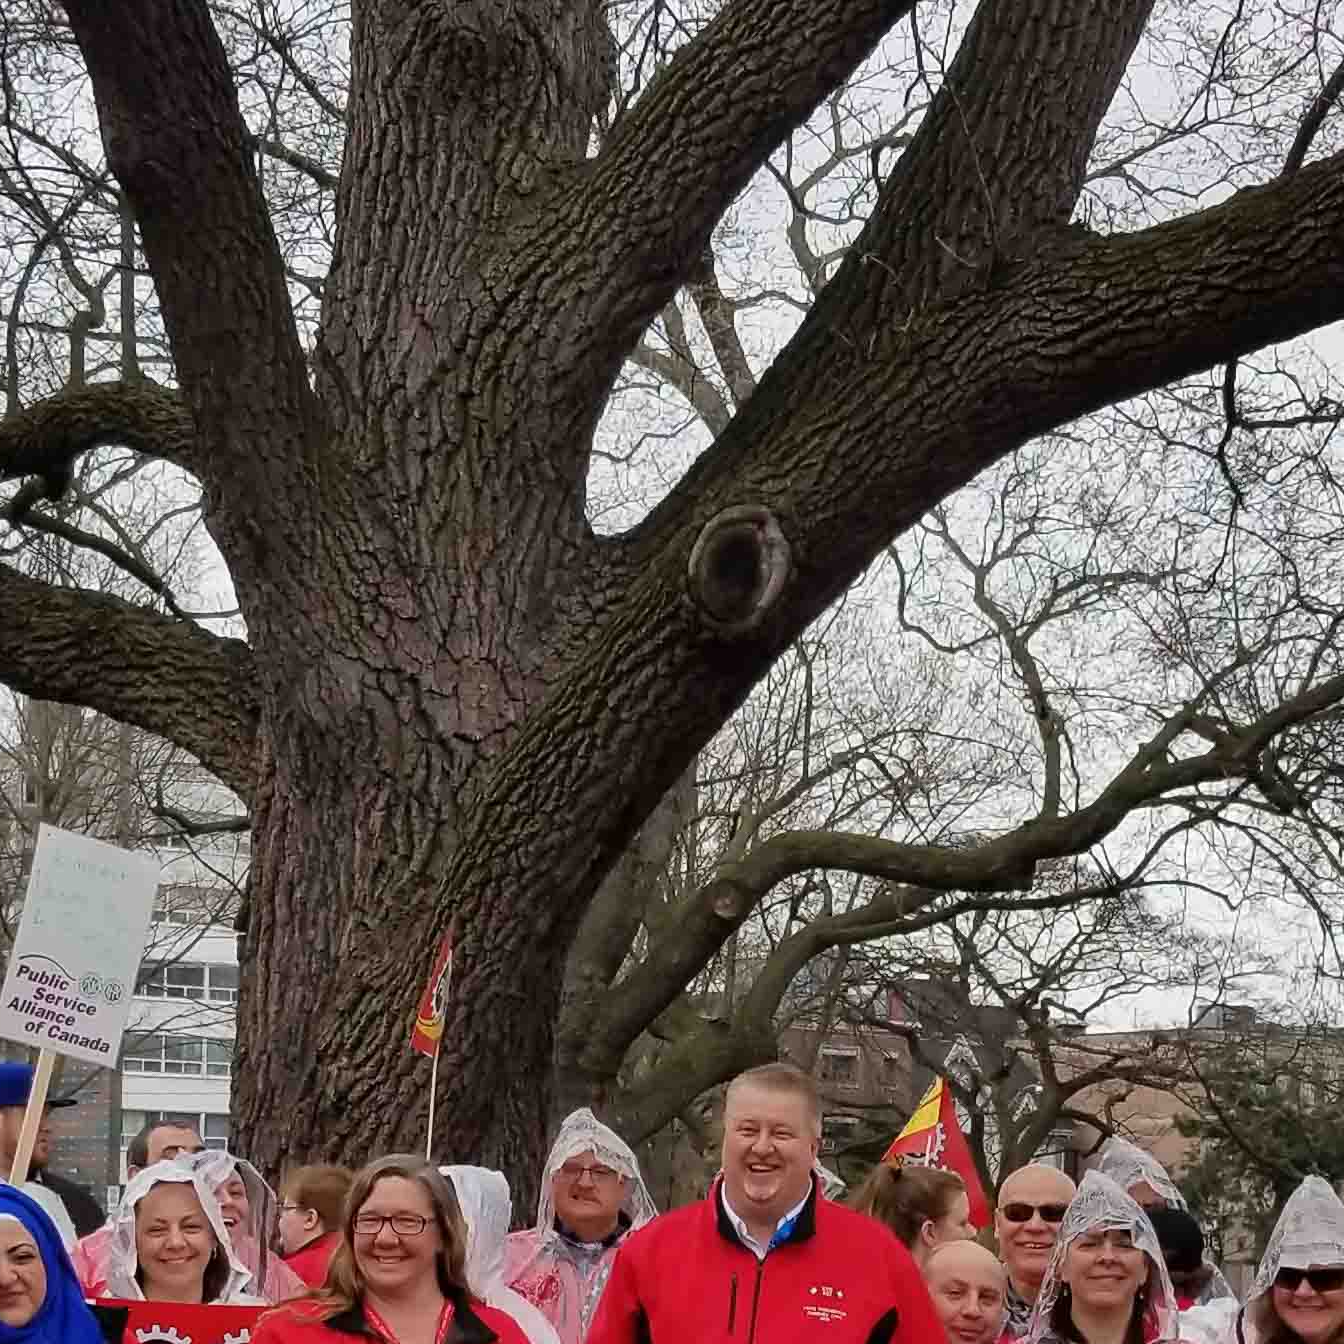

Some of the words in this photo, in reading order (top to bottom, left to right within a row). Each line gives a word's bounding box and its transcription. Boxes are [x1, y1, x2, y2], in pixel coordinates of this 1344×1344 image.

[16, 964, 70, 991] Public
[7, 996, 76, 1027] Alliance
[32, 986, 97, 1016] Service
[24, 1020, 46, 1035] of
[47, 1025, 111, 1054] Canada
